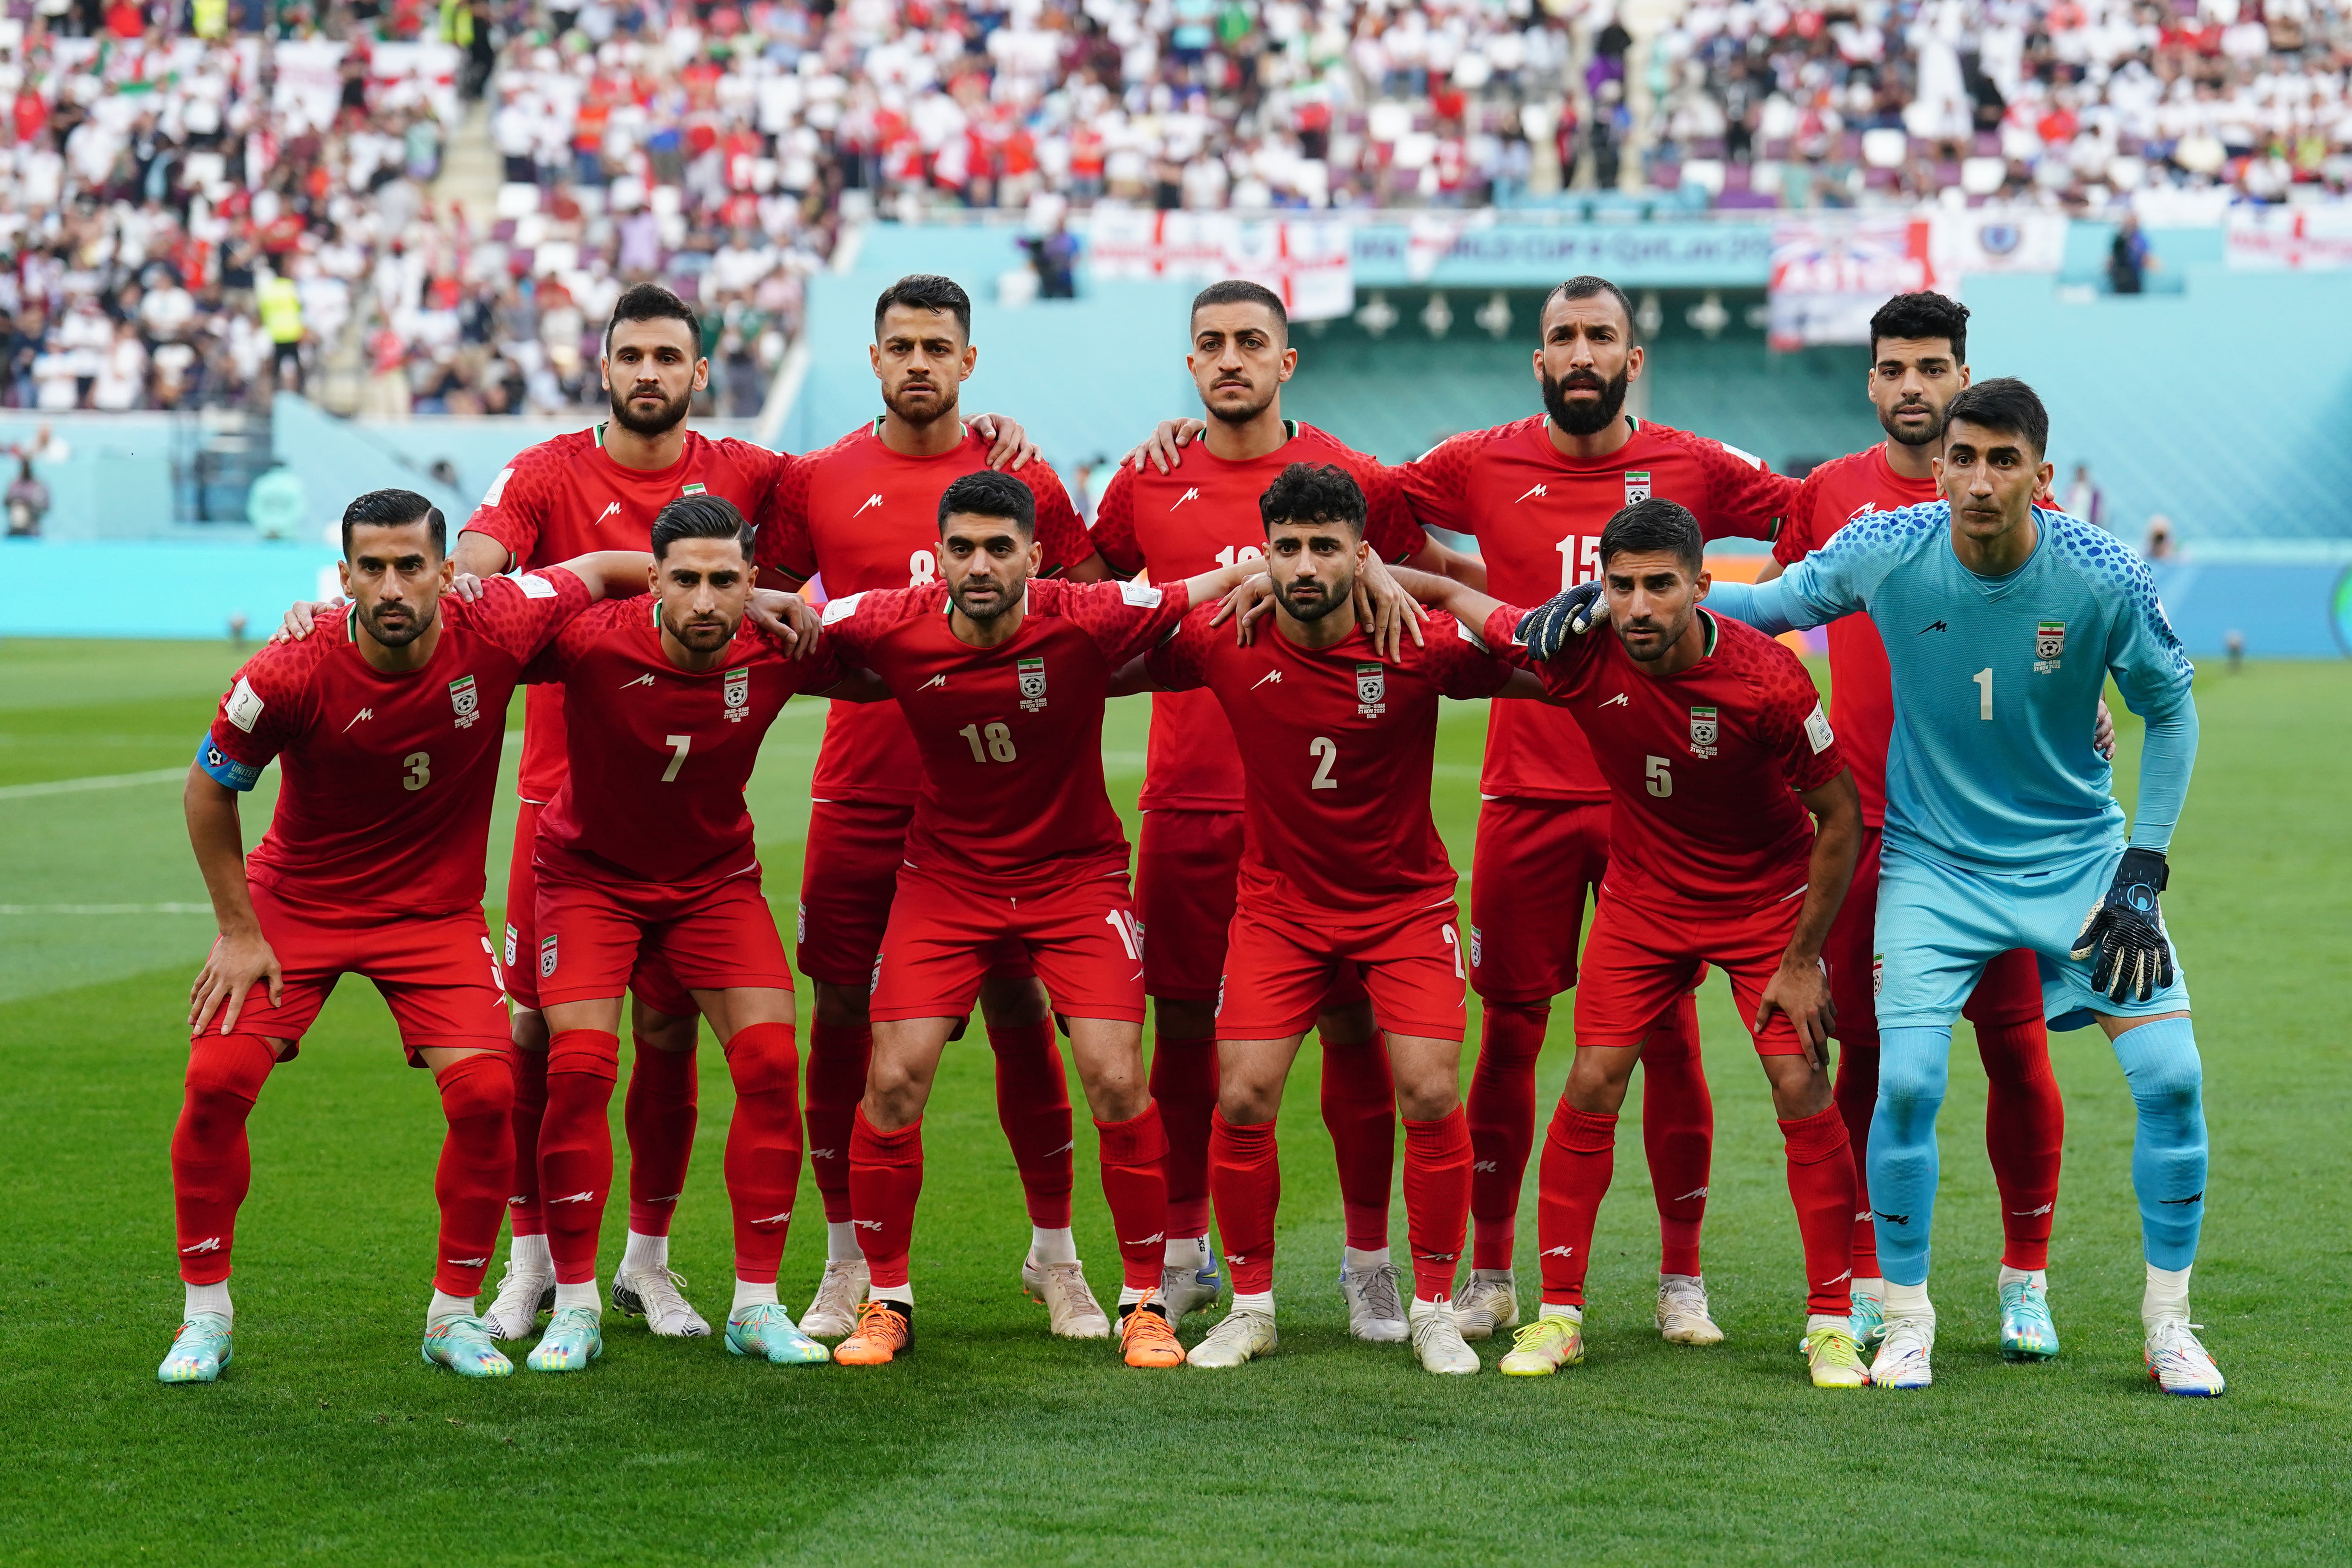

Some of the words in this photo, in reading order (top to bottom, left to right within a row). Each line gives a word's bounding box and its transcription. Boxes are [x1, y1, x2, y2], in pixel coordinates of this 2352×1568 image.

[909, 550, 935, 588] 8
[1555, 535, 1602, 593] 15
[1973, 667, 1993, 720] 1
[469, 714, 480, 722] 2022
[661, 735, 691, 782] 7
[959, 722, 1016, 763] 18
[1310, 737, 1337, 790] 2
[231, 764, 258, 778] UNITES
[403, 752, 430, 791] 3
[1646, 755, 1672, 797] 5
[1442, 924, 1466, 981] 2
